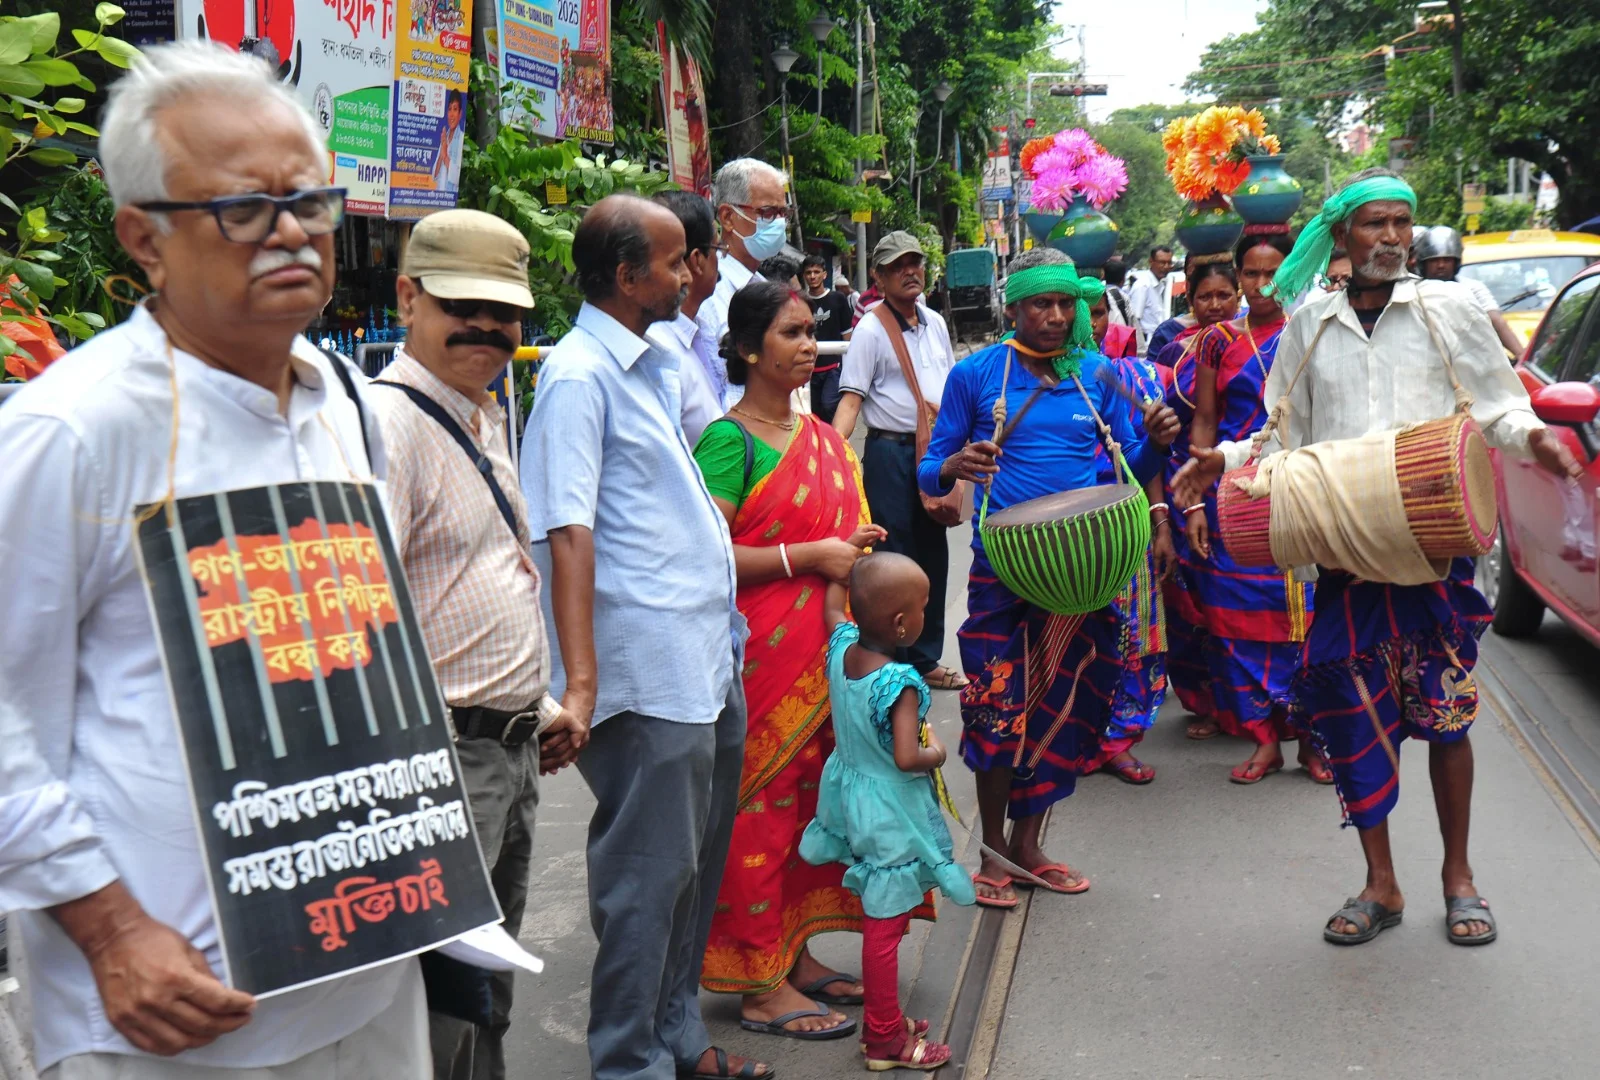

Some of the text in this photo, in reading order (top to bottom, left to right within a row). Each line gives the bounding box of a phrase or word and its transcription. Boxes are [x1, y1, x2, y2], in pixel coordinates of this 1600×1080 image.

[557, 0, 579, 26] 2025
[369, 46, 387, 69] শহীদ
[565, 124, 614, 142] ALL ARE INVITED
[357, 164, 387, 185] HAPPY
[191, 534, 383, 585] গণ-আন্দোলনে
[313, 574, 395, 619] নিপীড়ন
[263, 630, 369, 674] বন্ধ কর
[212, 747, 455, 837] পশ্চিমবঙ্গ সহ সারা দেশের
[222, 845, 298, 896] সমস্ত
[292, 807, 416, 885] রাজনৈতিক
[304, 857, 450, 953] মুক্তি চাই
